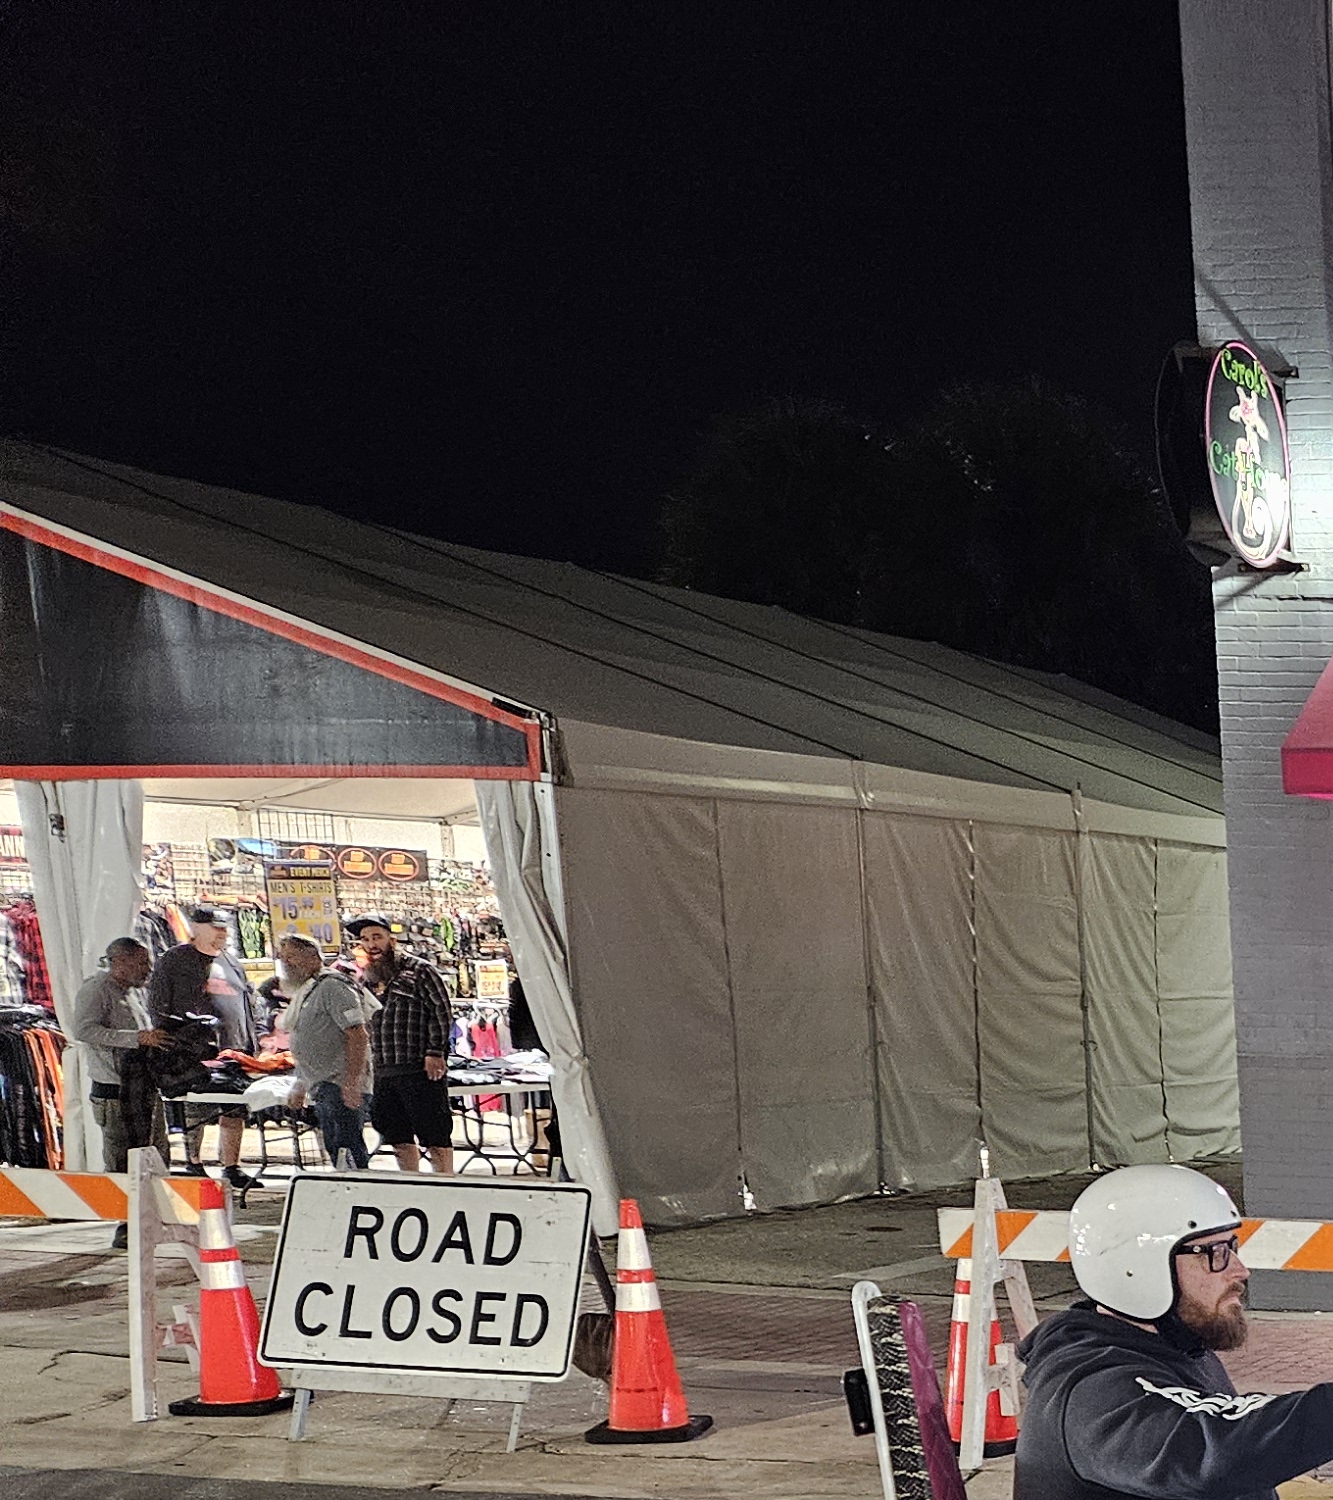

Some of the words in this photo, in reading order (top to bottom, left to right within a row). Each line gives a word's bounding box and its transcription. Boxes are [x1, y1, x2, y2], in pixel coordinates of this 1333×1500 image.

[1210, 440, 1239, 481] Cat
[270, 882, 296, 894] MEN'S
[299, 882, 332, 894] T-SHIRTS
[343, 1205, 523, 1266] ROAD
[294, 1281, 550, 1347] CLOSED
